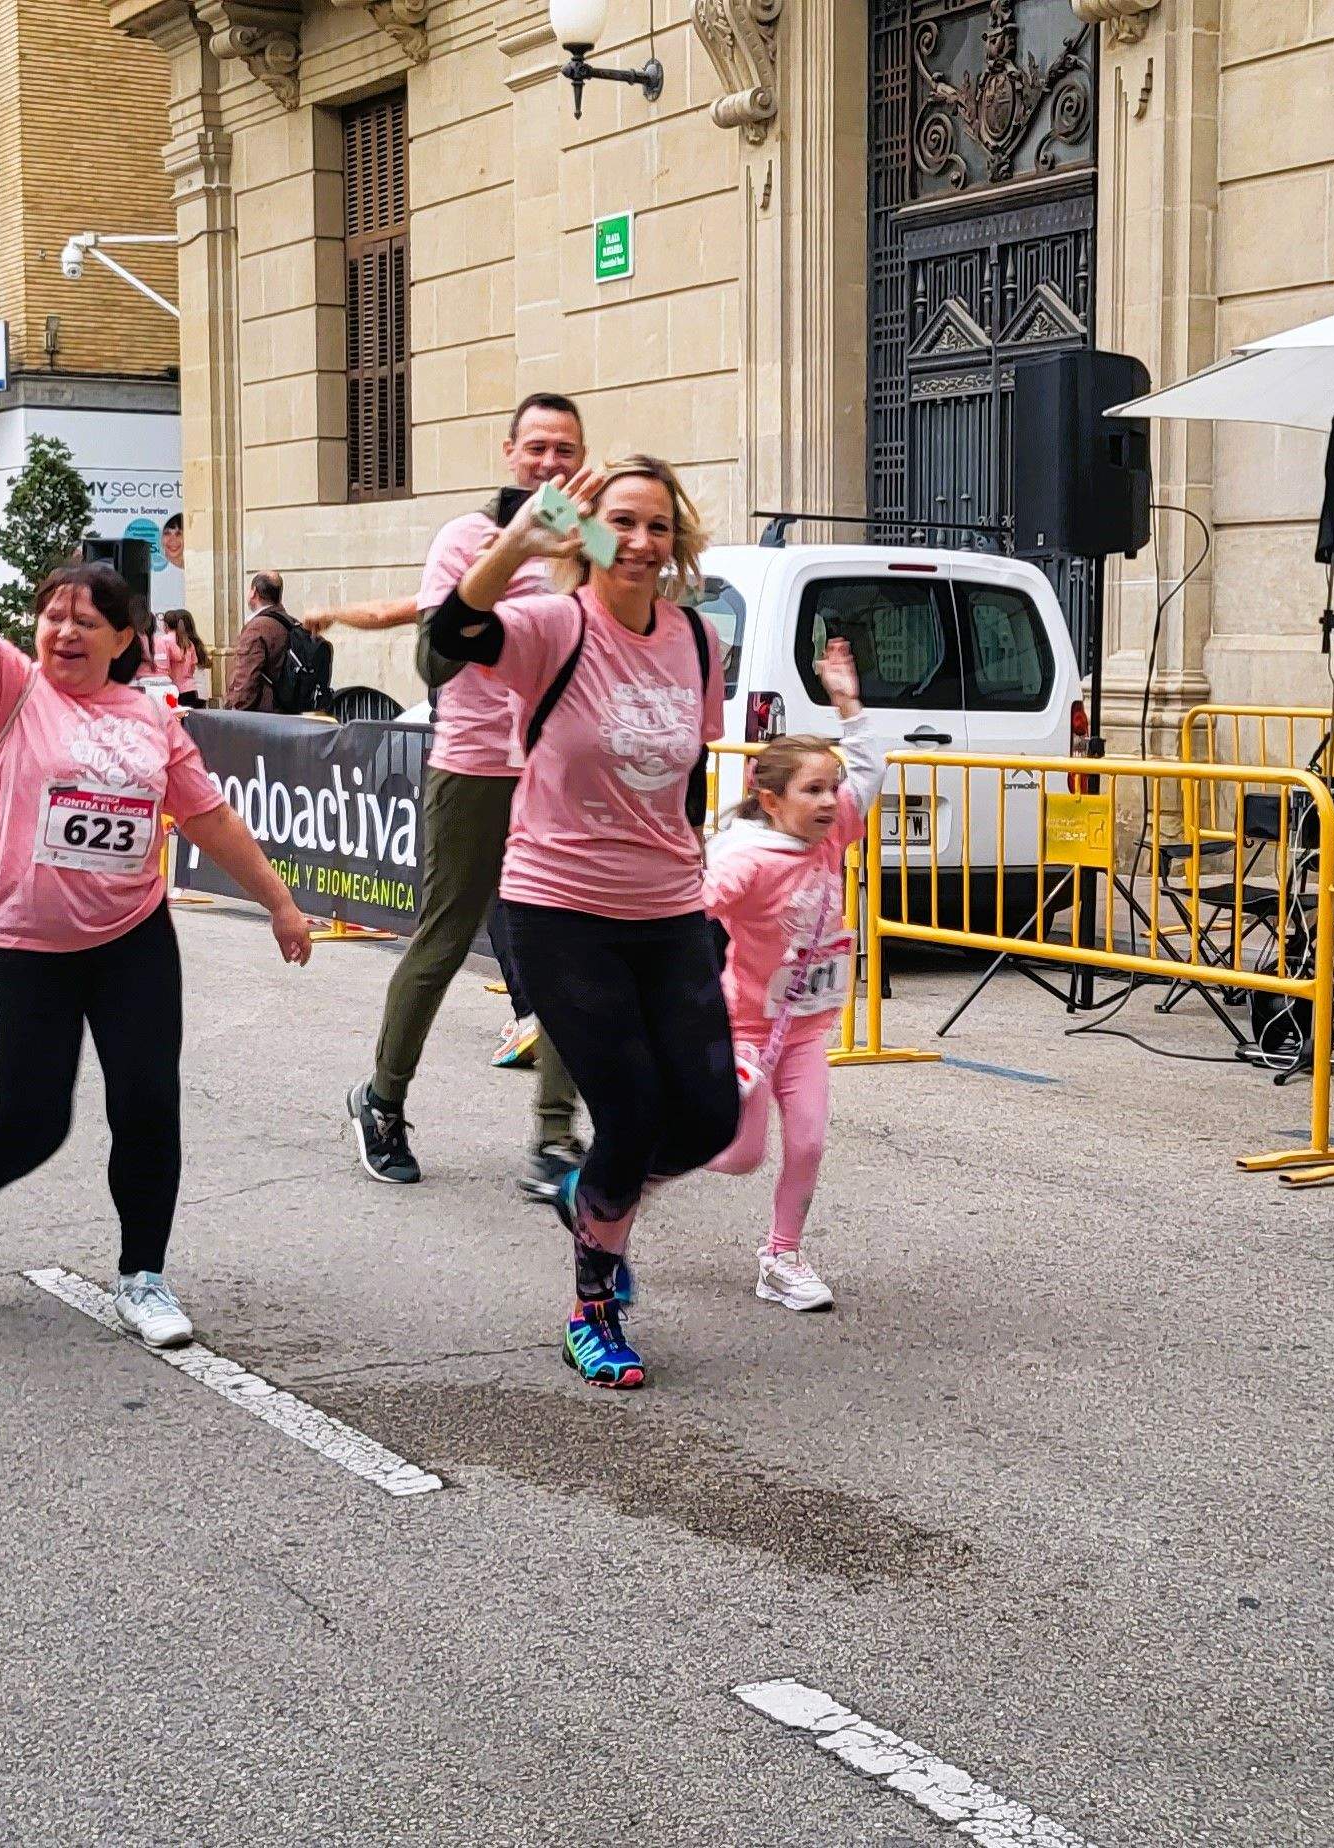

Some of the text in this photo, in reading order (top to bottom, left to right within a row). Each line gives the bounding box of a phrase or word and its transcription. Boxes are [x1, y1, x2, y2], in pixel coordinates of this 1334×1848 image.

[57, 797, 98, 809] CONTRA
[64, 815, 136, 852] 623
[317, 867, 415, 912] BIOMECÁNICA
